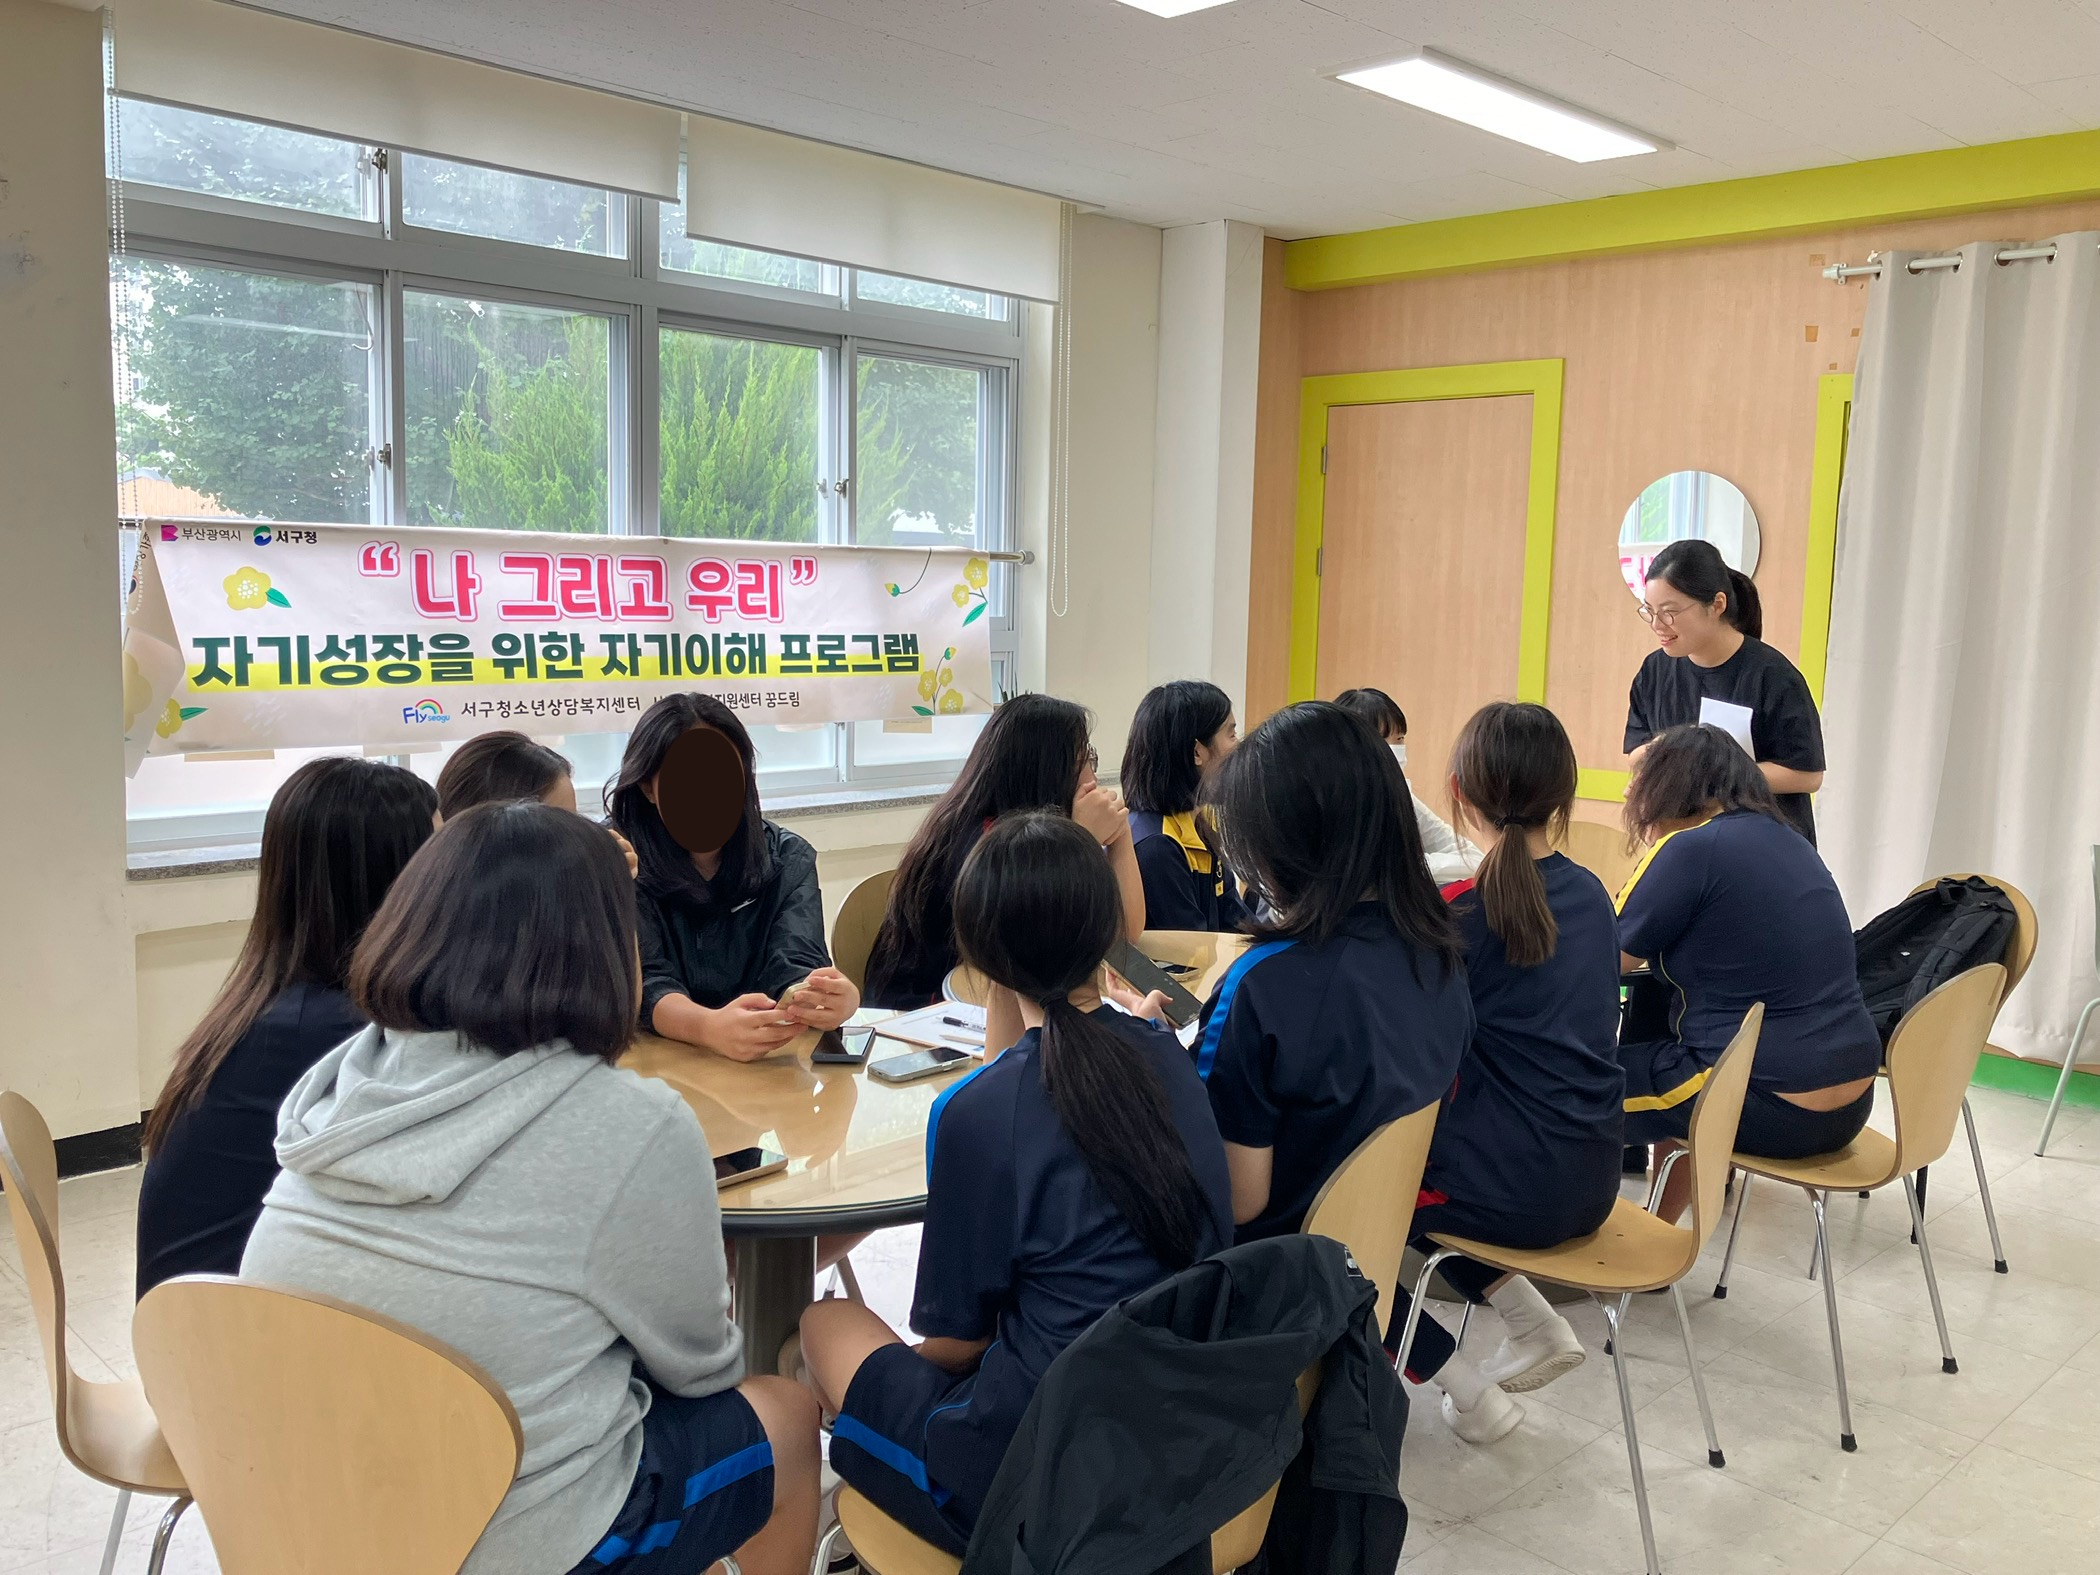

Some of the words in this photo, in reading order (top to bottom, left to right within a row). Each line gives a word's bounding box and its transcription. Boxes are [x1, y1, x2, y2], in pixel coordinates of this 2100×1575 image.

[182, 527, 242, 541] 부산광역시
[276, 530, 317, 544] 서구청
[498, 552, 673, 622] 그리고
[192, 633, 474, 688] 자기성장을
[491, 632, 585, 680] 위한
[600, 633, 767, 676] 자기이해
[780, 633, 920, 674] 프로그램
[402, 706, 428, 724] Fly
[461, 696, 641, 719] 서구청소년상담복지센터
[765, 691, 800, 708] 꿈드림
